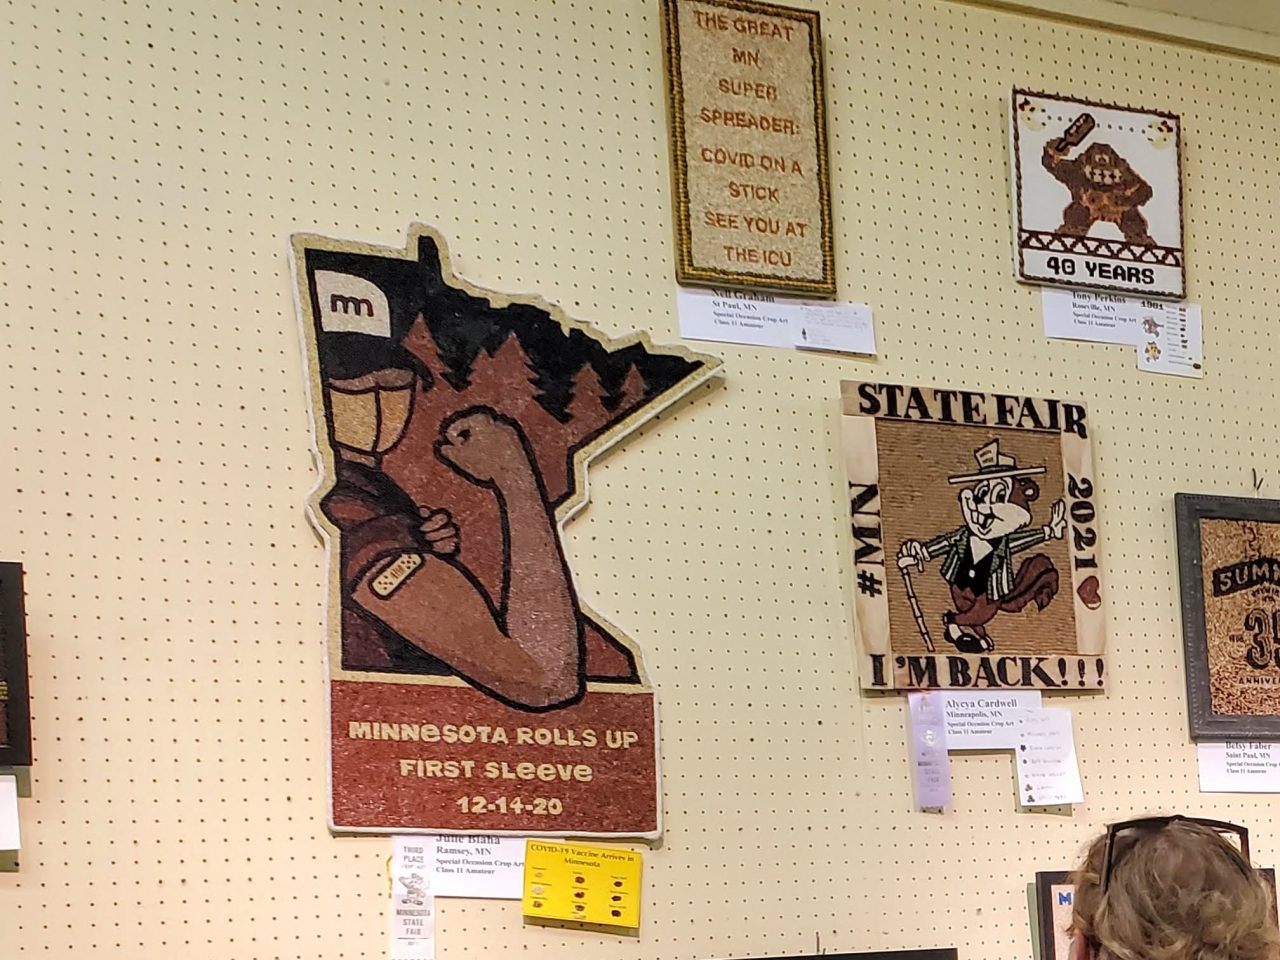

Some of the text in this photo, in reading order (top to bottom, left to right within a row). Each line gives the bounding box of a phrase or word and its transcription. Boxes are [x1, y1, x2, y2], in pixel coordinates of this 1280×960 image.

[693, 10, 794, 42] THE GREAT
[732, 47, 761, 67] MN
[718, 78, 778, 101] SUPER
[701, 148, 803, 178] COVID ON A
[728, 181, 780, 202] STICK
[704, 211, 808, 239] SEE YOU AT
[724, 245, 792, 268] THE ICU
[1047, 257, 1155, 285] 40 YEARS
[743, 303, 757, 311] MN
[858, 383, 1090, 439] STATE FAIR
[1066, 472, 1099, 570] 2021
[848, 480, 885, 598] #MN
[517, 727, 598, 748] ROLLS
[605, 731, 639, 750] UP
[400, 759, 475, 779] FIRST
[456, 796, 564, 816] 12-14-20
[436, 846, 492, 856] Ramsey, MN
[571, 849, 599, 858] Vaccine
[436, 858, 461, 867] Special
[462, 858, 493, 867] Occasion
[494, 860, 512, 868] Crop
[564, 858, 600, 868] Minnesota
